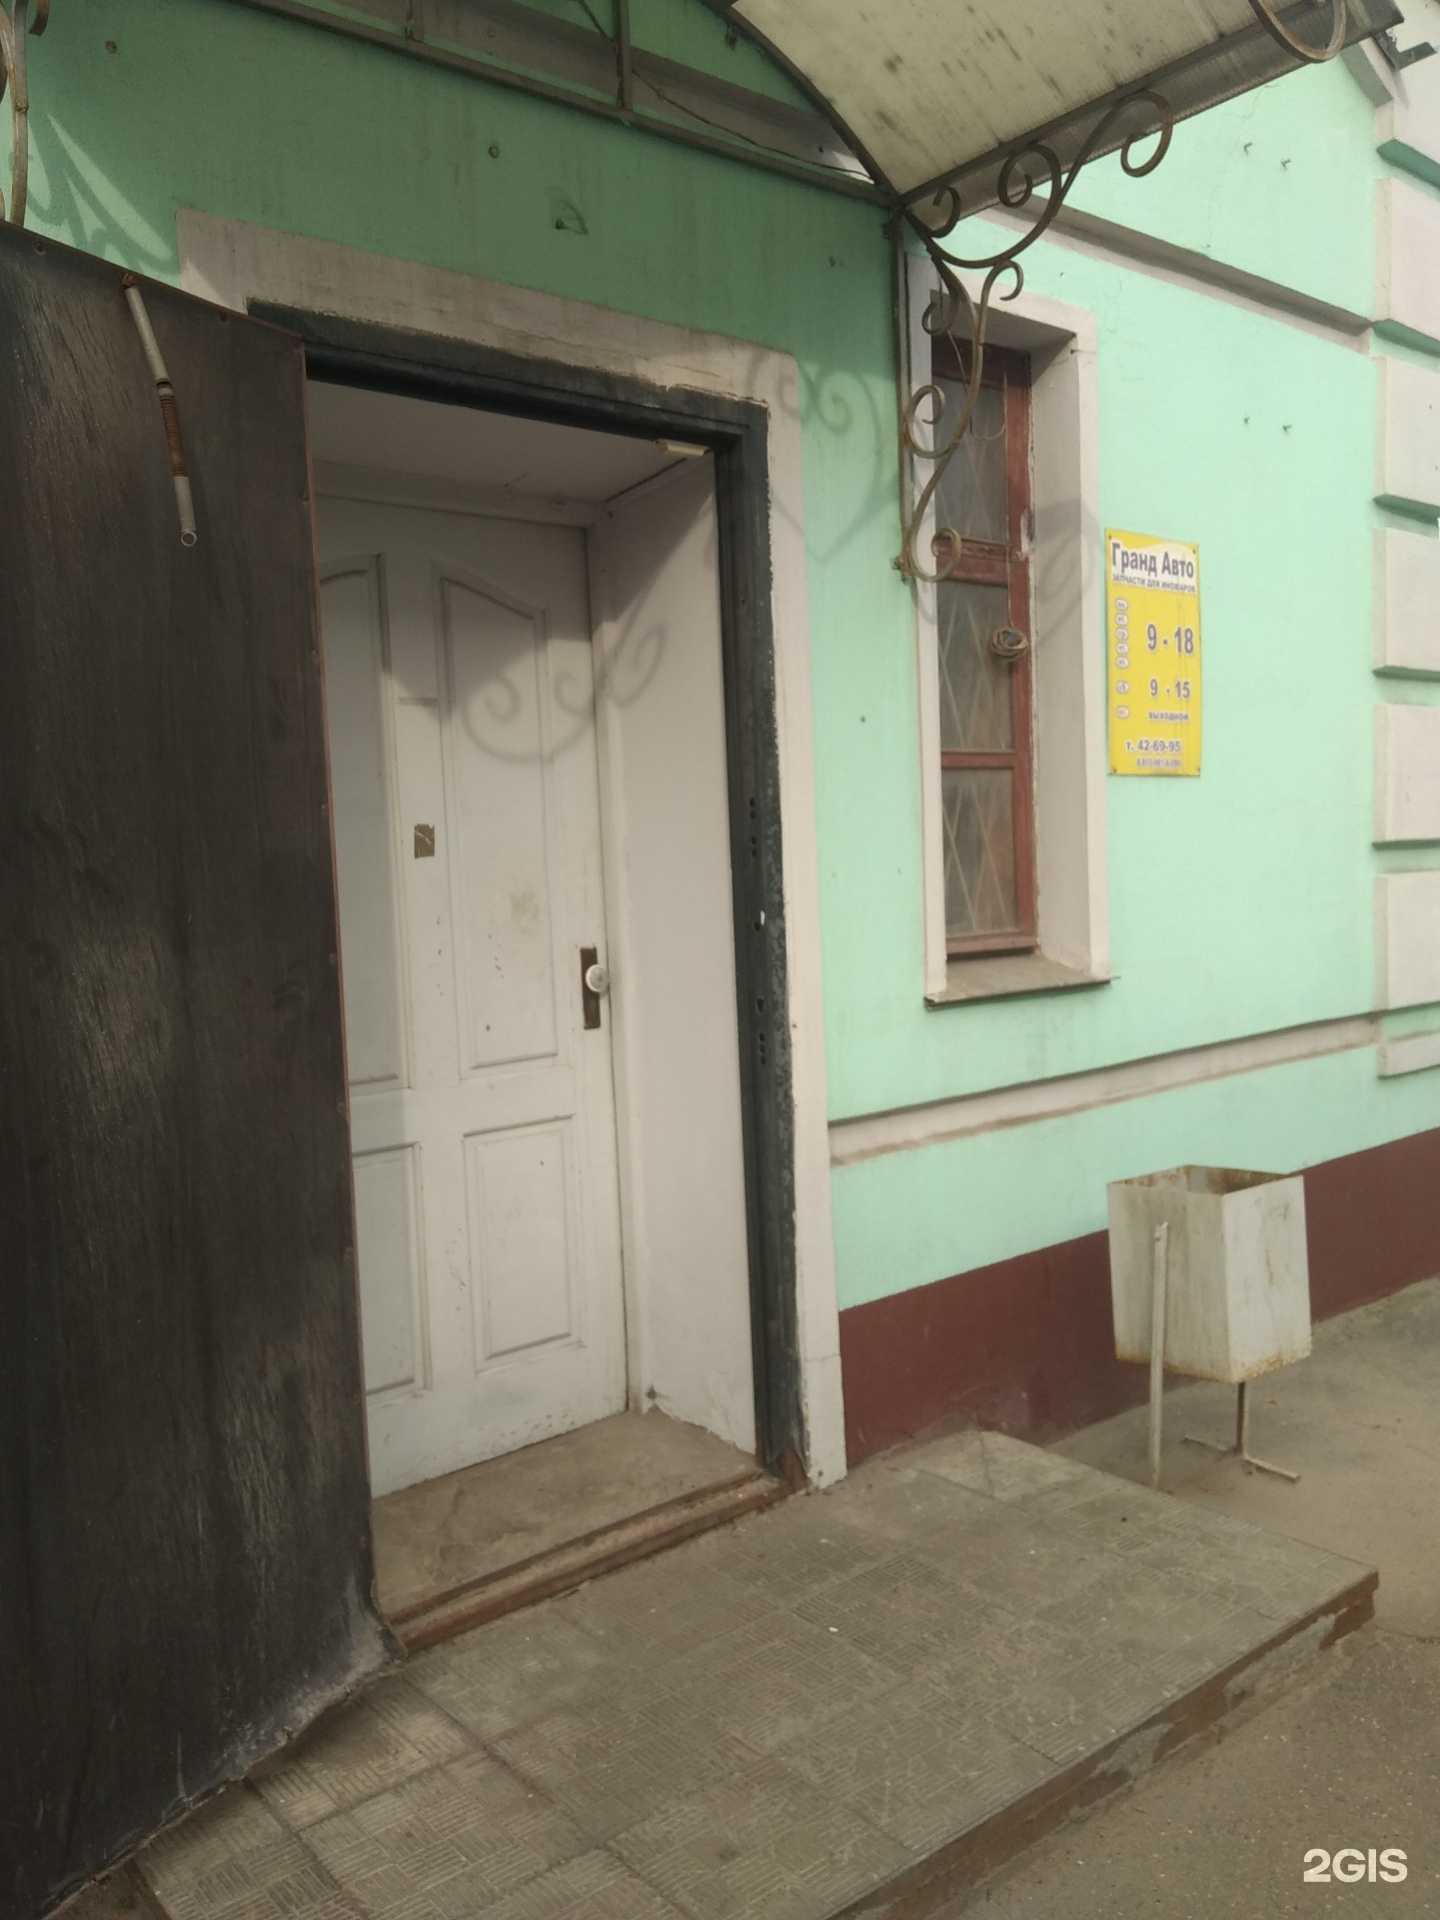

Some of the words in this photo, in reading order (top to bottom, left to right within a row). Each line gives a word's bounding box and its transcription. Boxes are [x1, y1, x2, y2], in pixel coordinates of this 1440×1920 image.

[1112, 542, 1157, 577] Гранд
[1162, 551, 1194, 578] Авто
[1147, 624, 1157, 650] 9
[1174, 627, 1194, 654] 18
[1150, 679, 1158, 696] 9
[1175, 681, 1190, 699] 15
